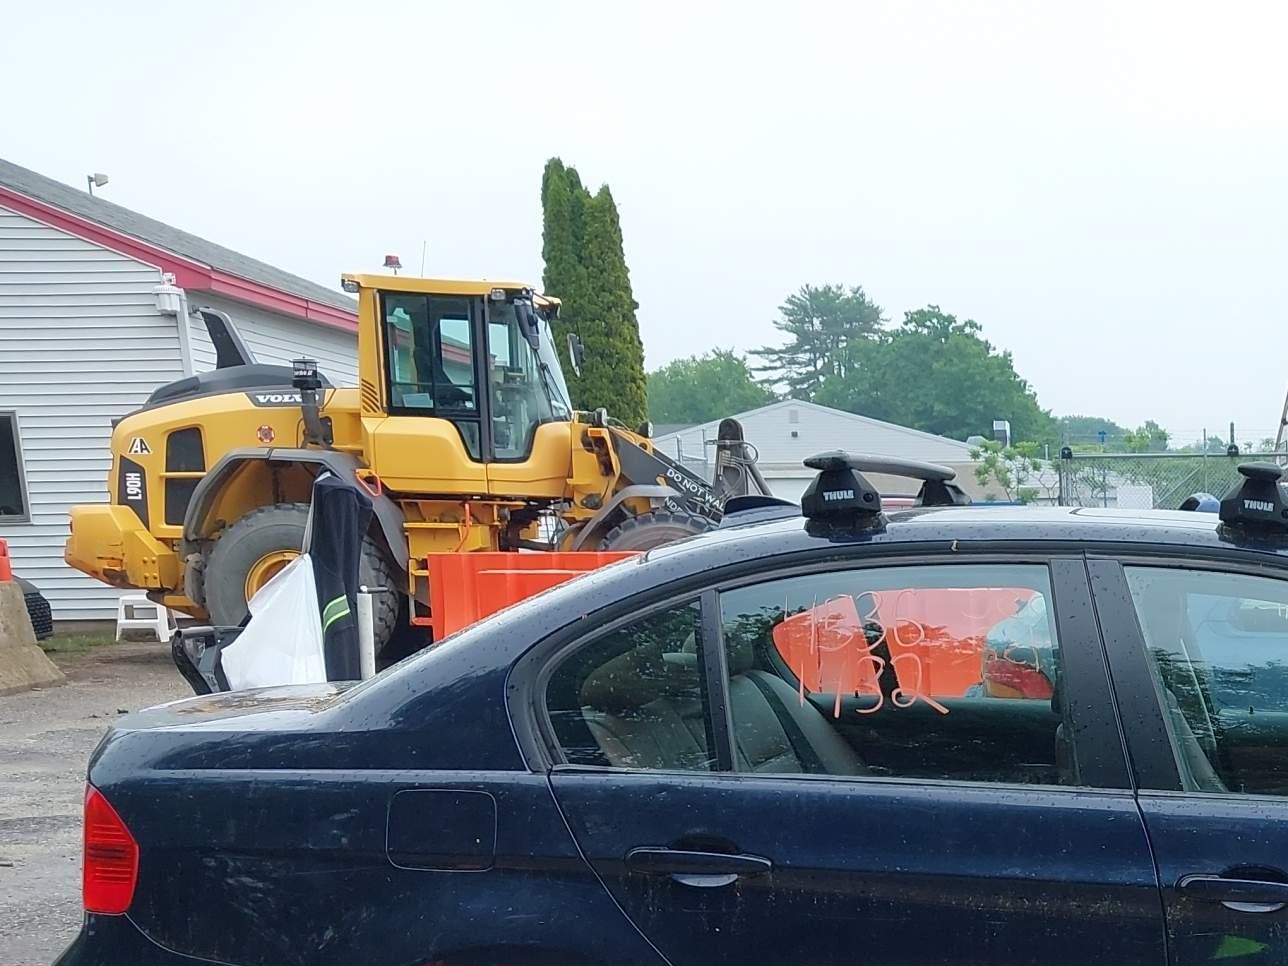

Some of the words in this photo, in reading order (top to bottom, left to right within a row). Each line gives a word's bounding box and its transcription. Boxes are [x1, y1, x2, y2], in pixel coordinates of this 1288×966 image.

[256, 394, 319, 403] VOLV
[125, 472, 142, 500] L90H
[666, 468, 682, 482] DO
[682, 479, 704, 496] NOT
[705, 492, 725, 511] WAL
[823, 490, 855, 501] THULE
[1243, 500, 1274, 512] THULE
